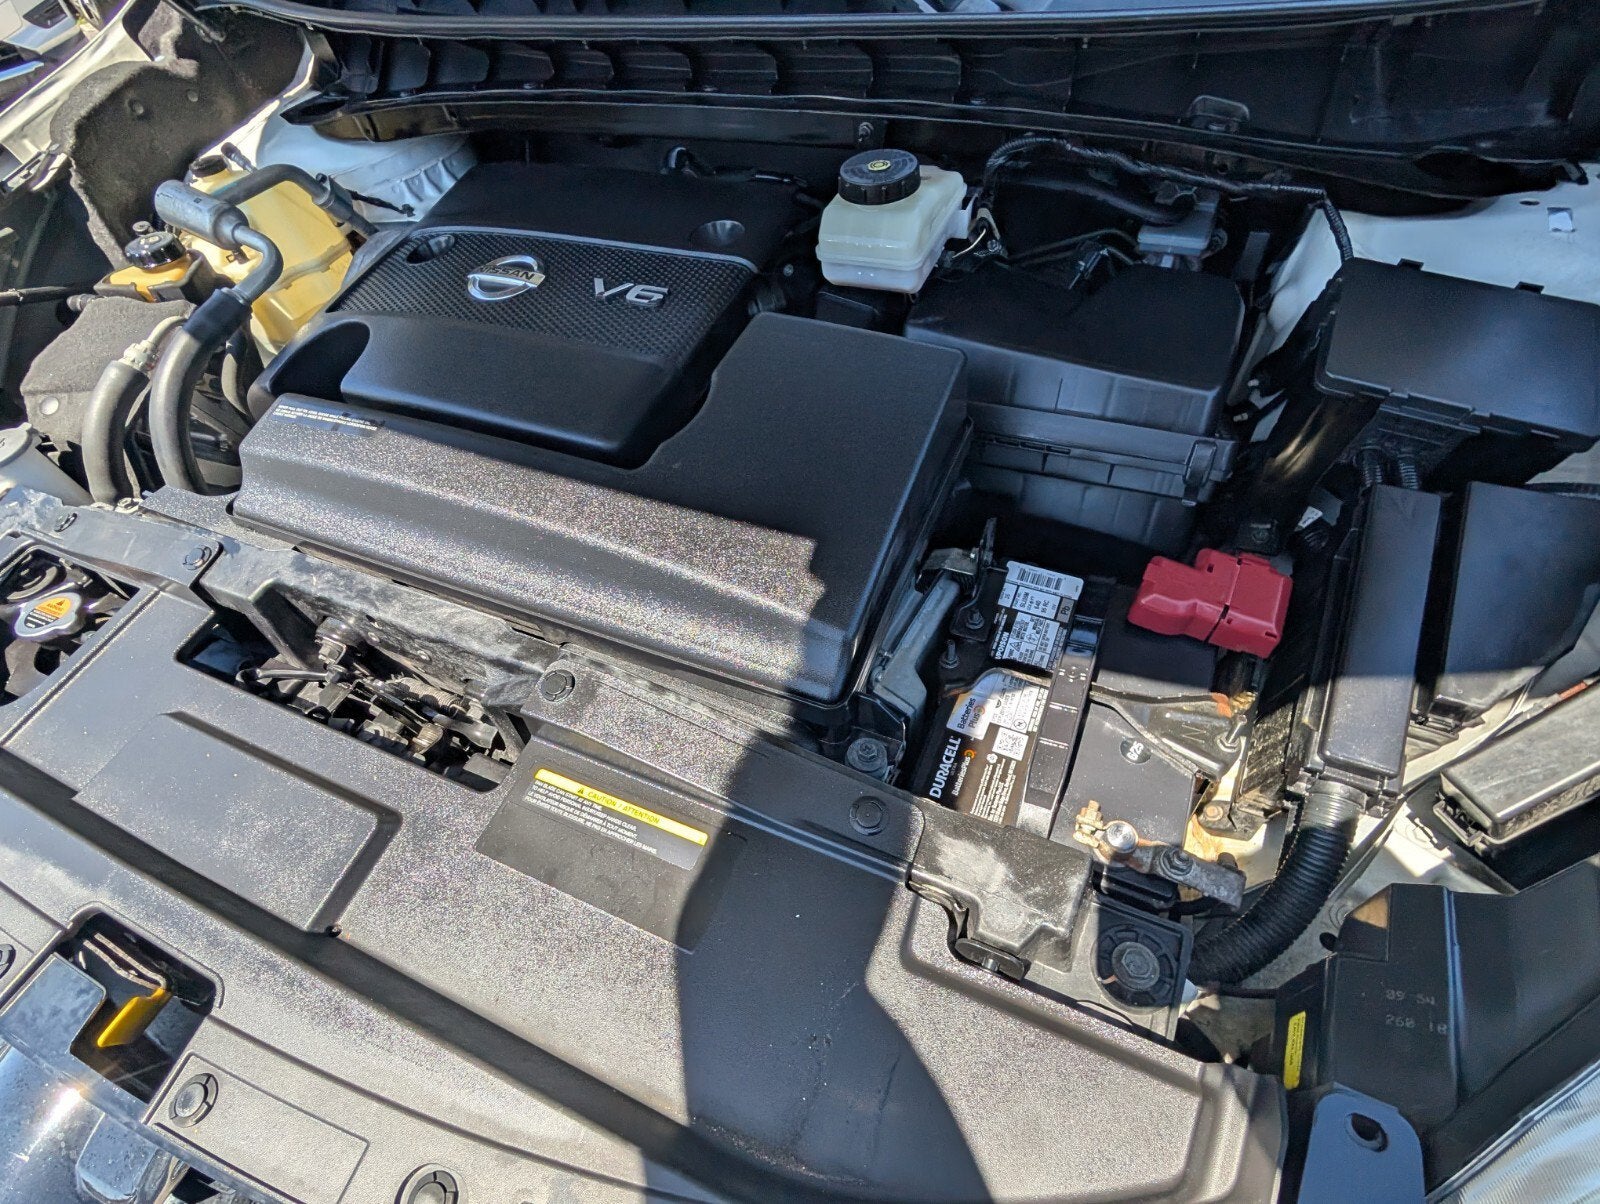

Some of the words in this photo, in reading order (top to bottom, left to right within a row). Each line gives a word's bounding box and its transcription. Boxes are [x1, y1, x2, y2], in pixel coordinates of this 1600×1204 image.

[479, 265, 535, 281] NISSAN
[594, 277, 669, 306] V6
[1060, 604, 1070, 615] Pb
[956, 695, 976, 730] Batteries
[967, 710, 980, 728] Plus
[928, 734, 961, 798] DURACELL
[950, 754, 971, 796] BatteriesPlus
[587, 791, 617, 806] CAUTION
[622, 804, 660, 823] ATTENTION
